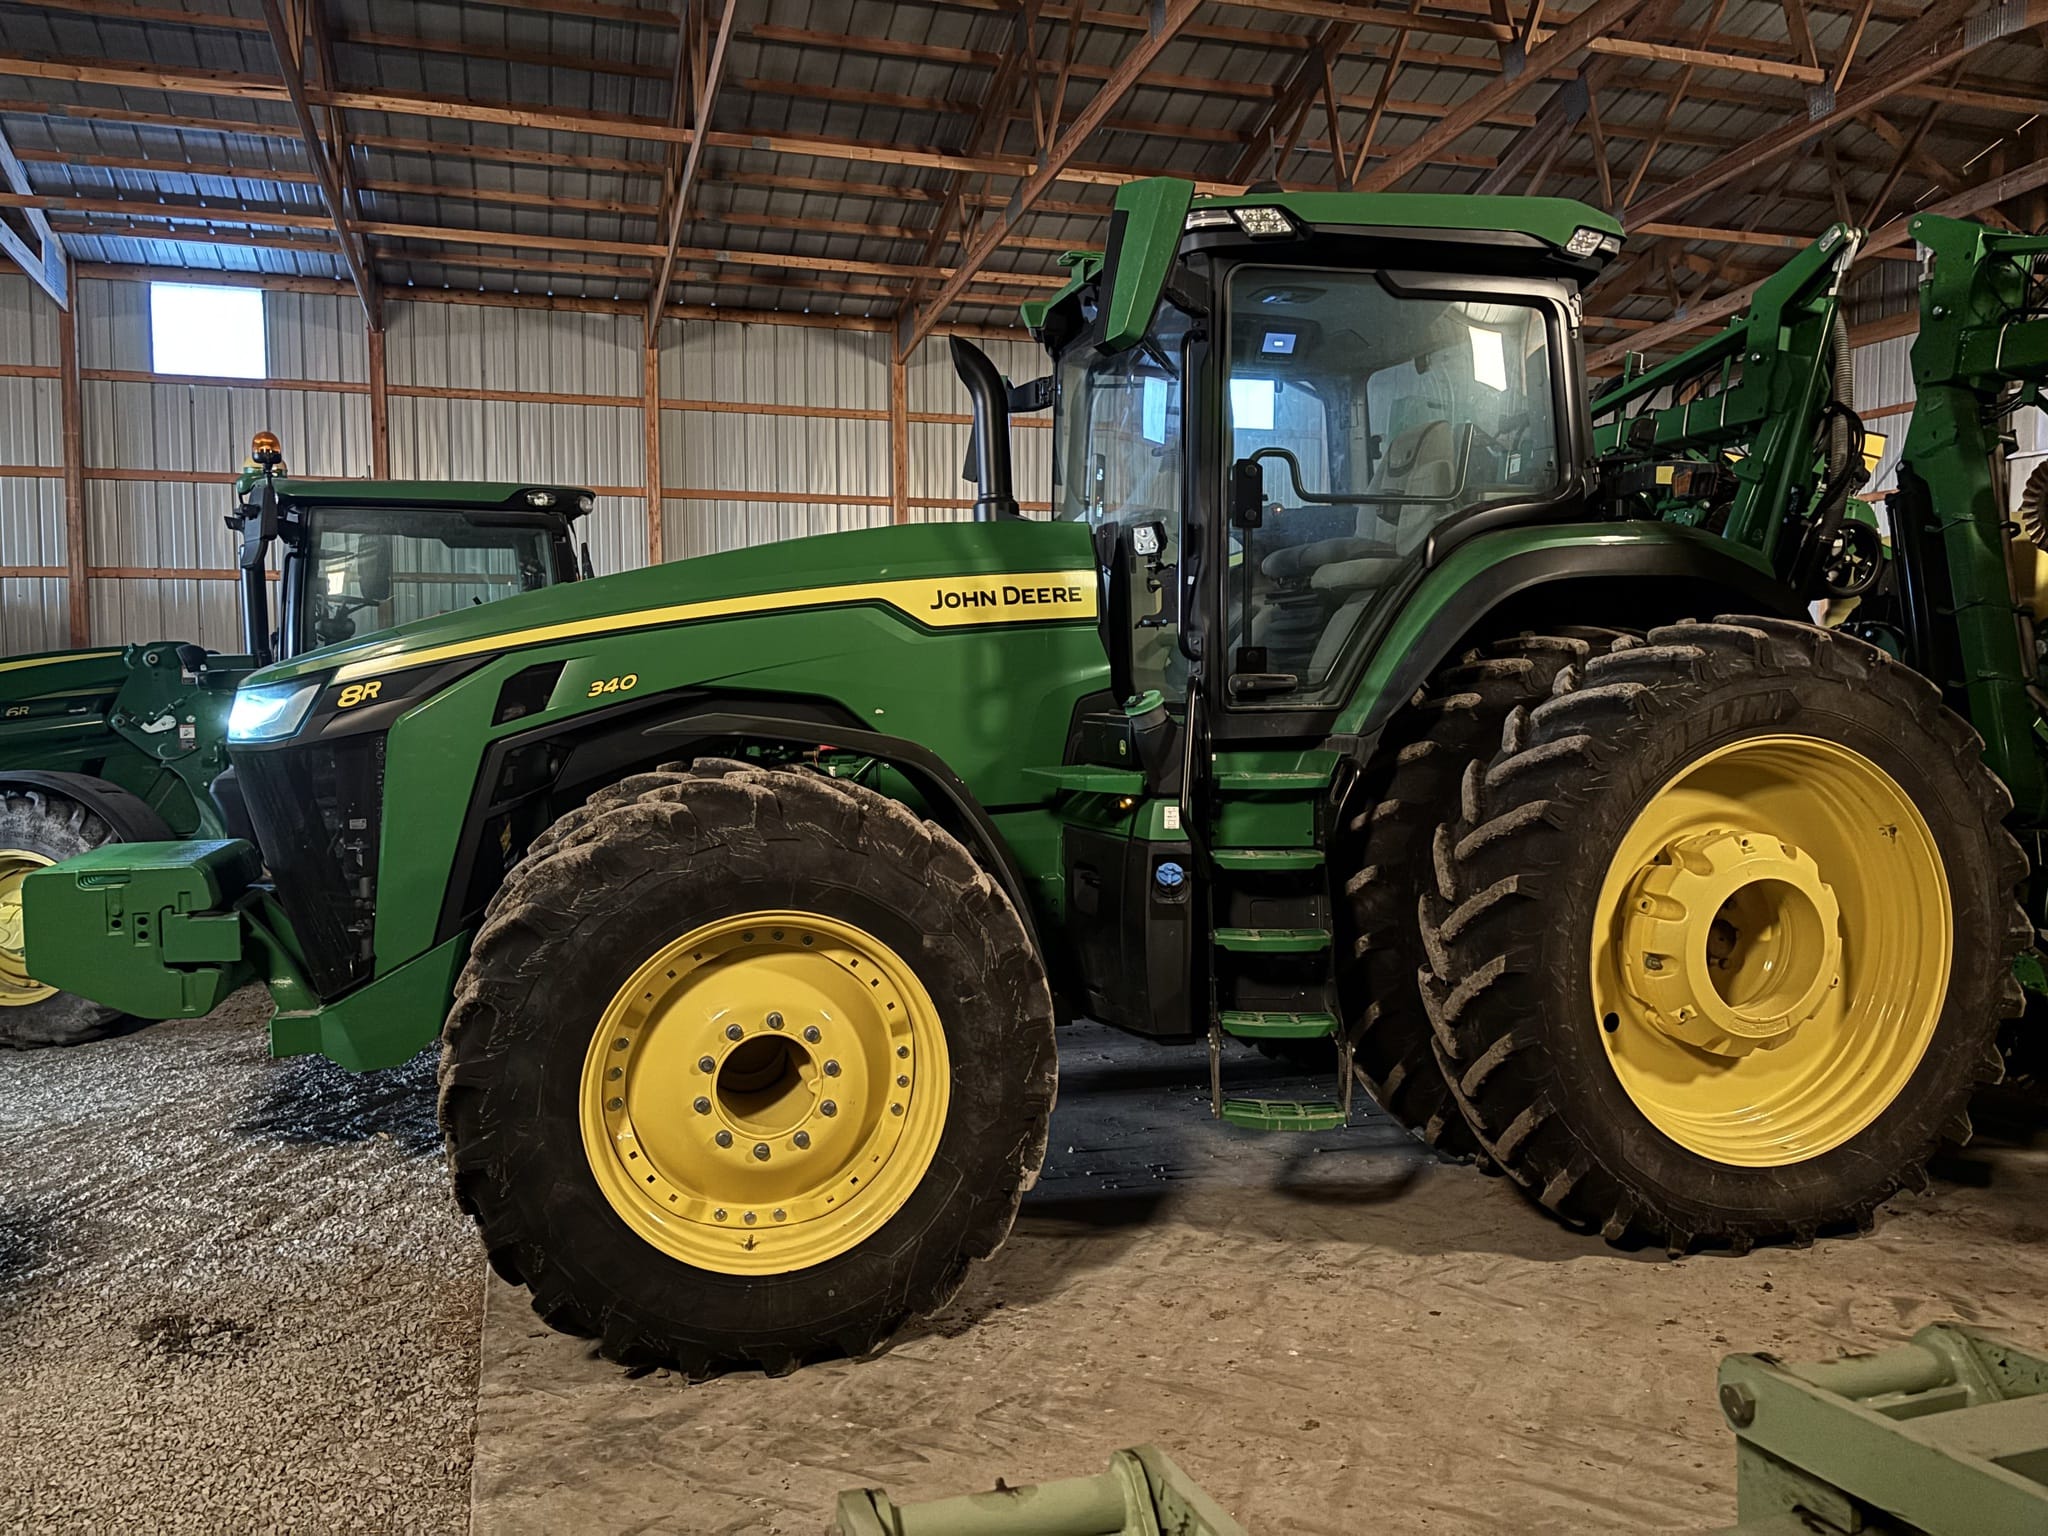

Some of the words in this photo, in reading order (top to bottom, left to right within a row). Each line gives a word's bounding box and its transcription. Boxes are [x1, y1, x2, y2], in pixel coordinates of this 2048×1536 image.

[930, 589, 997, 610] JOHN
[1002, 586, 1083, 605] DEERE
[337, 681, 382, 708] 8R
[587, 674, 638, 697] 340
[5, 706, 30, 717] 6R
